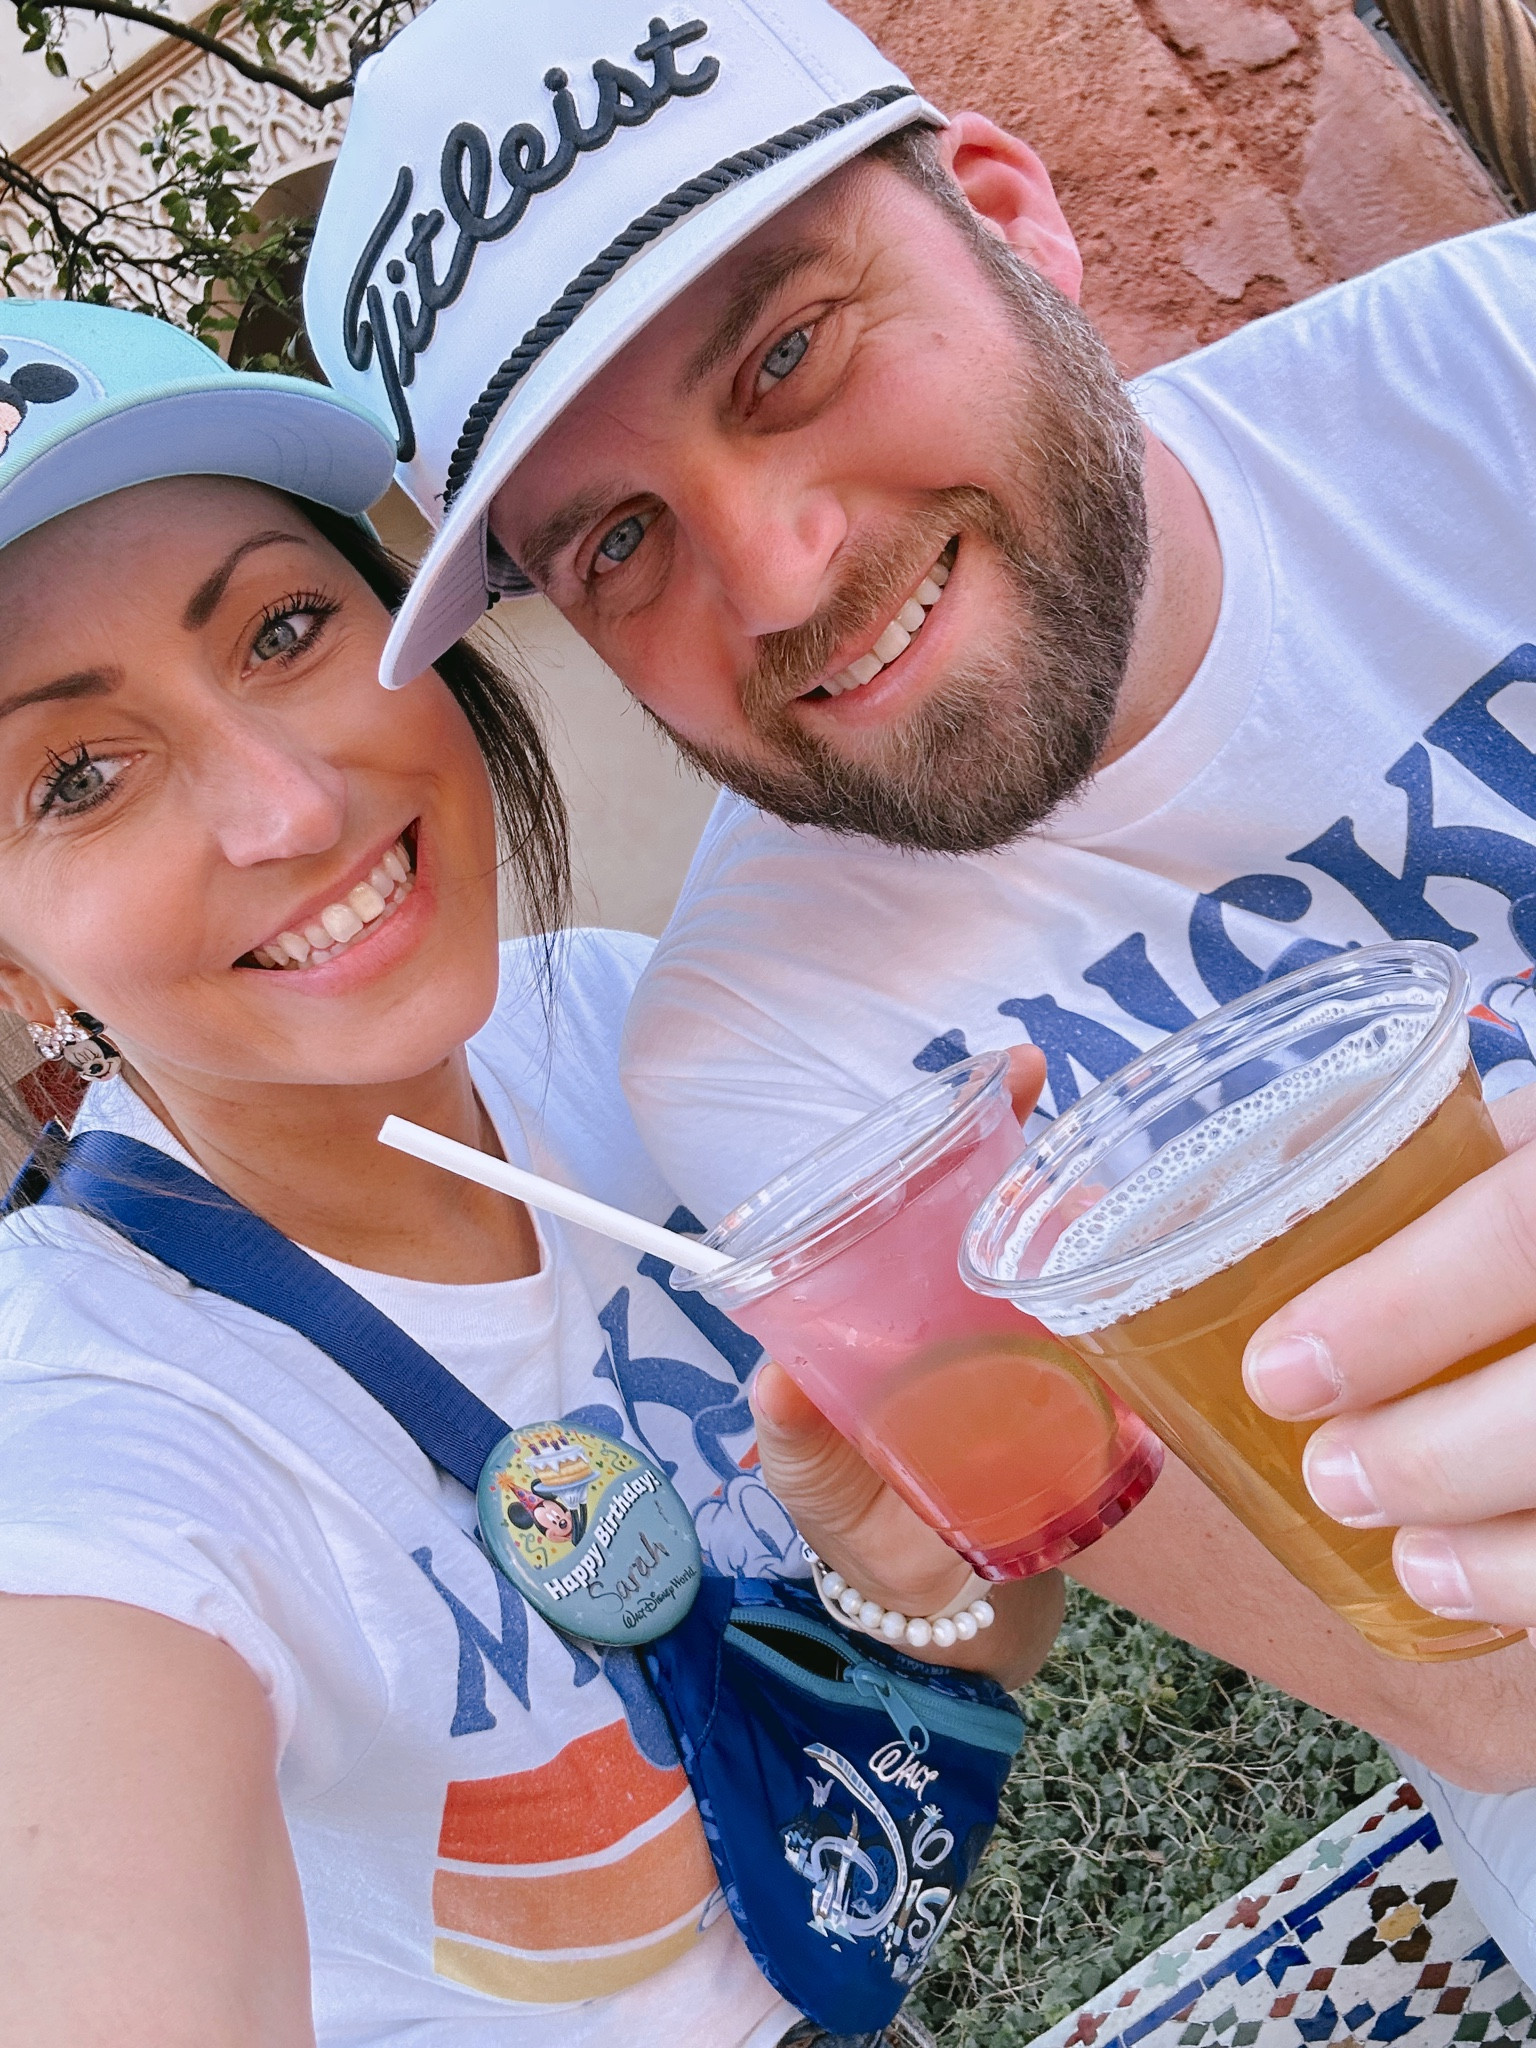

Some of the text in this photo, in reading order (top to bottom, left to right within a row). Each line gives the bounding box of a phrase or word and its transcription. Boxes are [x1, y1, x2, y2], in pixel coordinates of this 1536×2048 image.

[343, 16, 720, 462] Titleist
[544, 1469, 662, 1600] Happy Birthday!
[588, 1531, 670, 1612] Sarah
